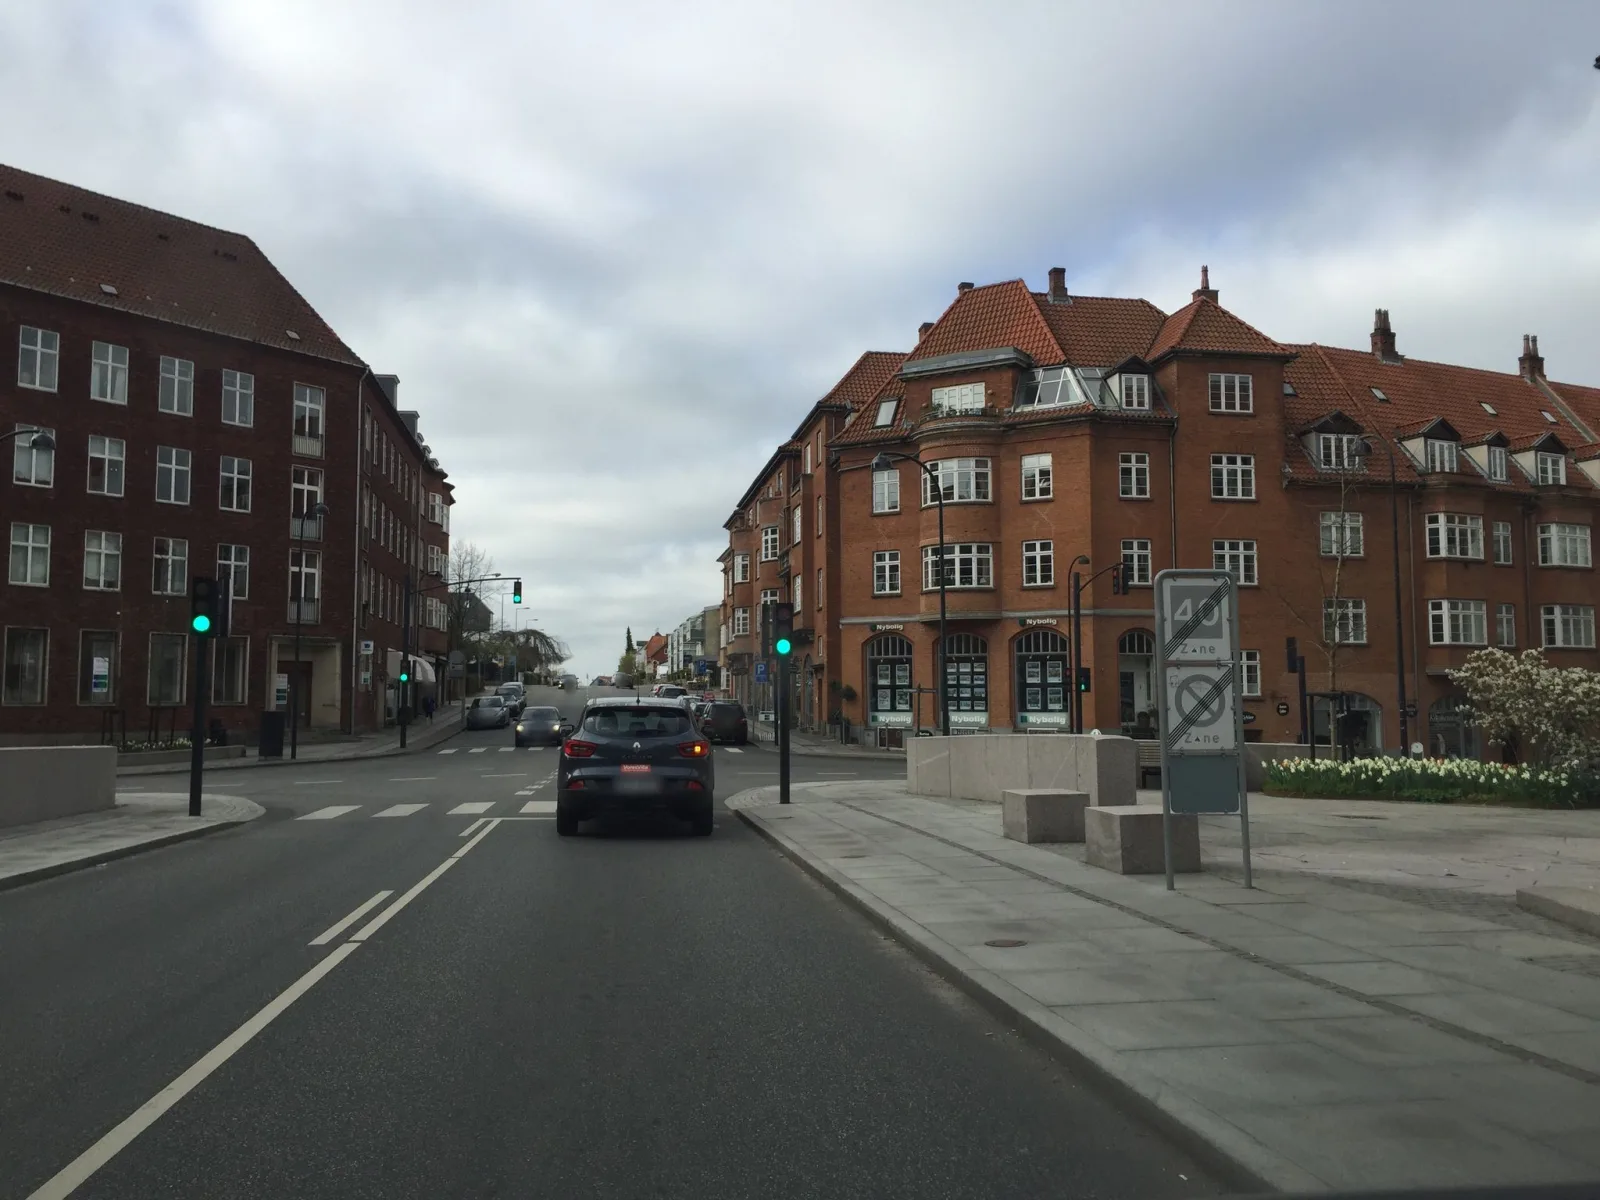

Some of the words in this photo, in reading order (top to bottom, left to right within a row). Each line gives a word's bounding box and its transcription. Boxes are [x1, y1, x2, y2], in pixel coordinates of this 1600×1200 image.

[1174, 598, 1219, 626] 40
[1026, 618, 1057, 626] Nybolig
[876, 624, 904, 632] Nybolig
[757, 664, 765, 675] P
[879, 715, 912, 723] Nybolig
[951, 715, 986, 724] Nybolig
[1029, 716, 1066, 724] Nybolig
